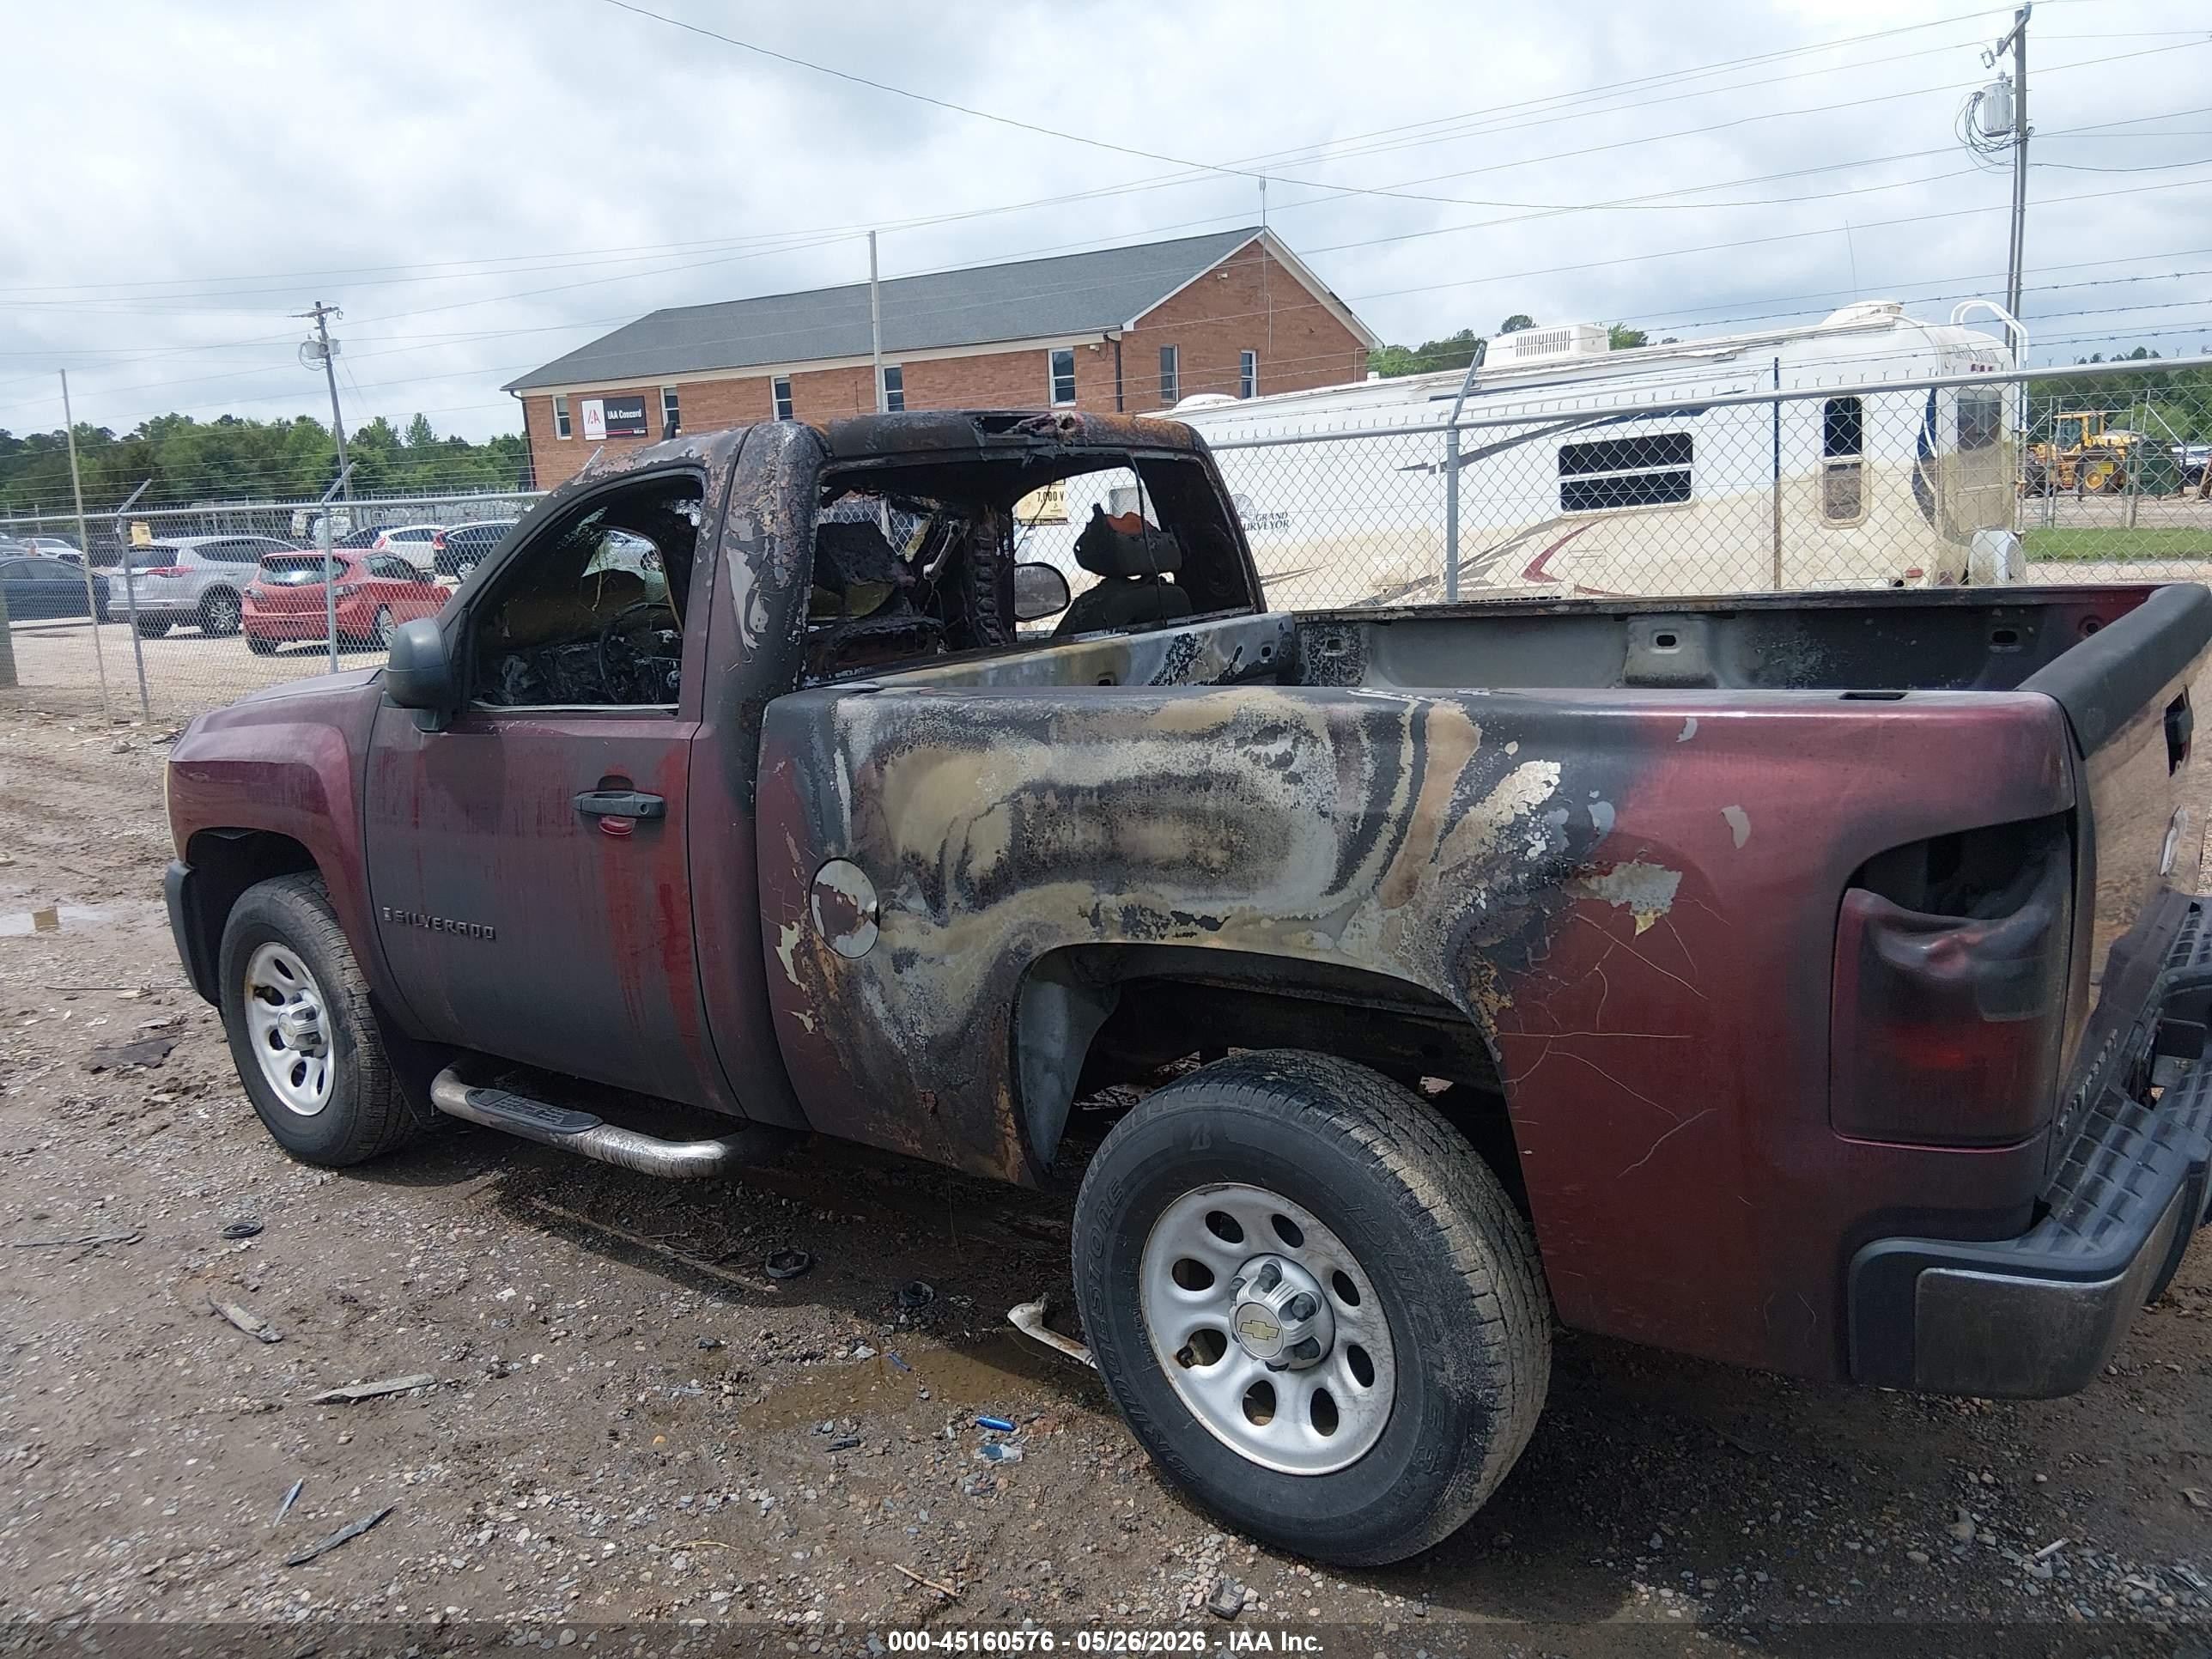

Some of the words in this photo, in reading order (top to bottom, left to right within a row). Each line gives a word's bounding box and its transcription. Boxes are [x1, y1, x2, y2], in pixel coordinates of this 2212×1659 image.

[607, 410, 618, 420] IAA
[619, 408, 642, 419] Concord
[1255, 511, 1288, 522] GRAND
[1243, 520, 1290, 532] URVEYOR
[395, 909, 495, 939] SILVERADO
